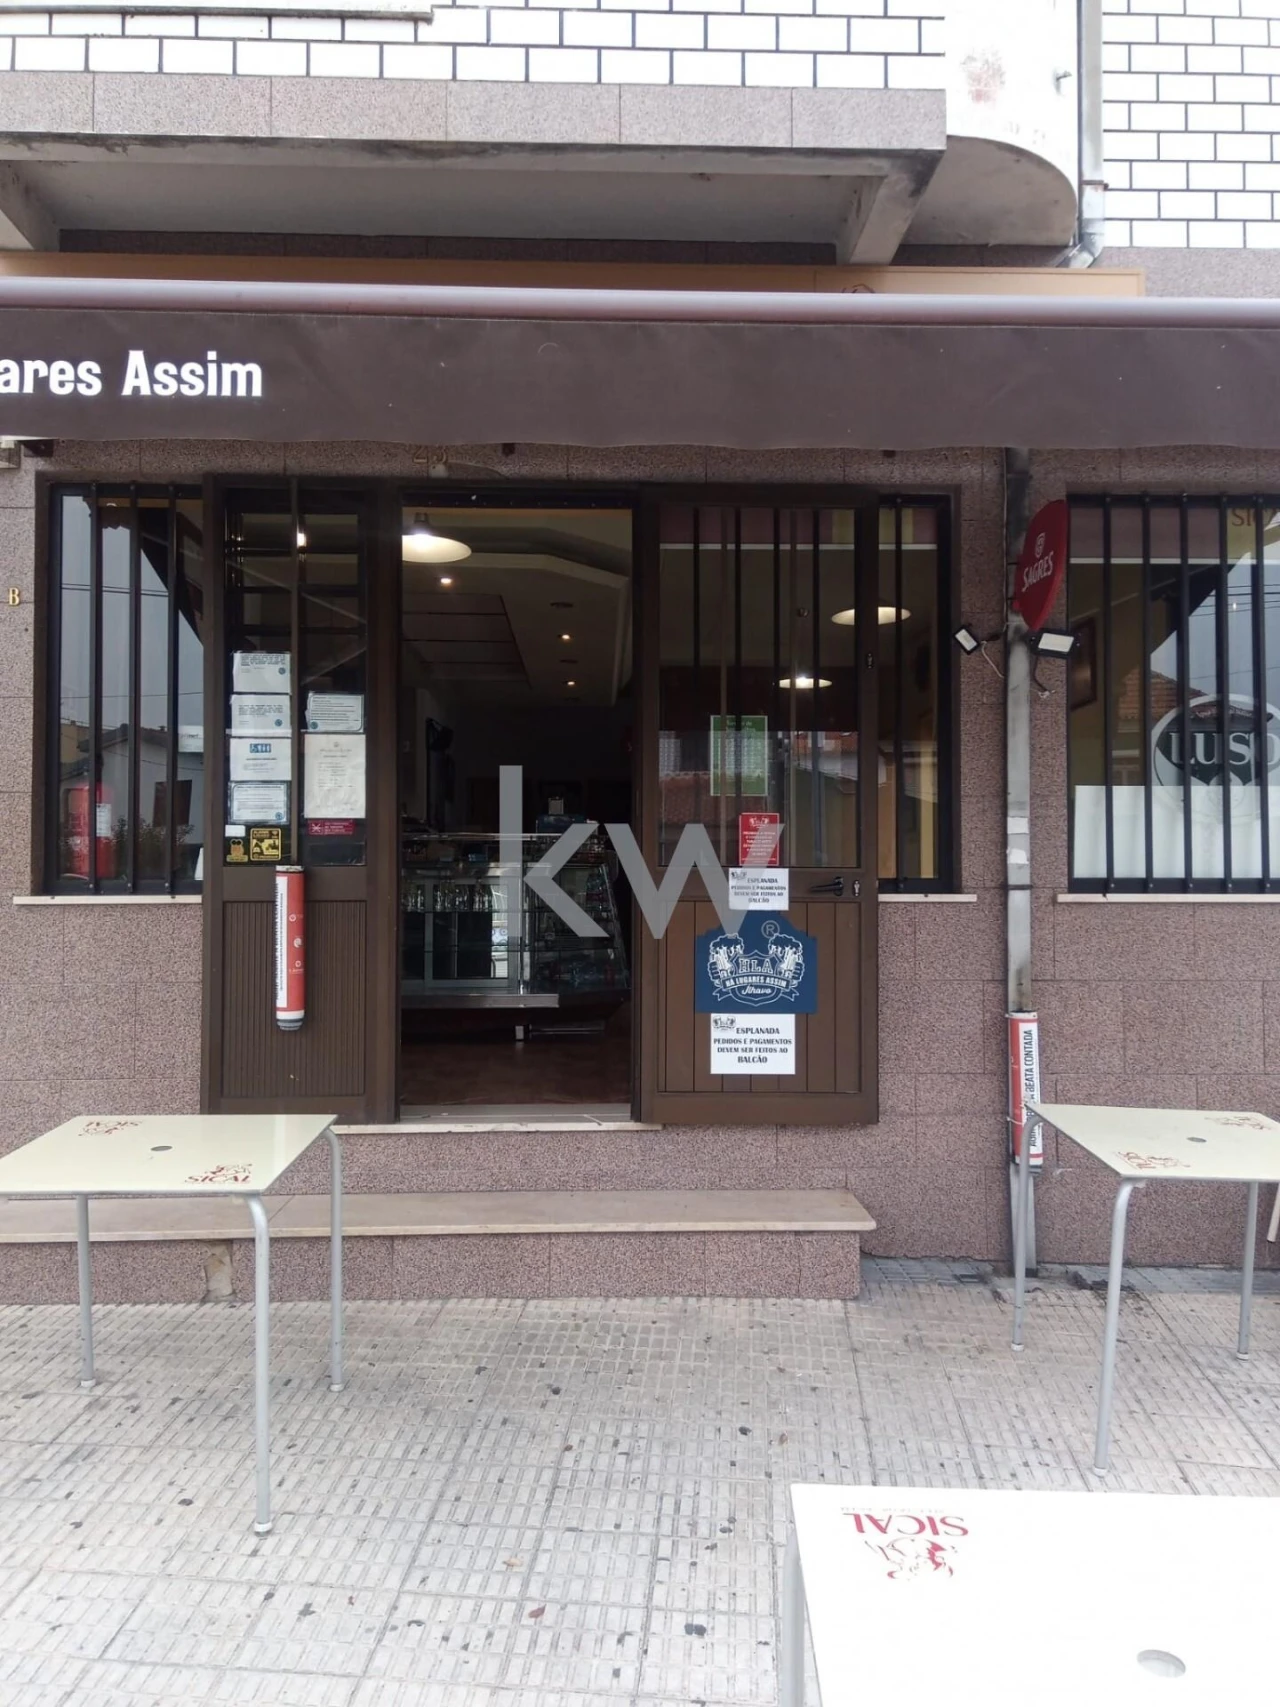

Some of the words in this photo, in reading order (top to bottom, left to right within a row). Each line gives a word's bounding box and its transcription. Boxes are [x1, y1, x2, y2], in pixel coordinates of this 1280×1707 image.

[0, 358, 102, 397] ares
[121, 350, 262, 397] Assim
[1022, 551, 1054, 593] SAGRES
[9, 586, 20, 606] B
[739, 958, 774, 974] HLA
[735, 975, 765, 985] LUGARES
[765, 976, 787, 988] ASSIM
[736, 1027, 780, 1035] ESPLANADA
[737, 1054, 768, 1063] BALCÃO
[1023, 1029, 1034, 1067] CONTADA
[1024, 1067, 1035, 1093] BEATA
[843, 1513, 969, 1537] SICAL
